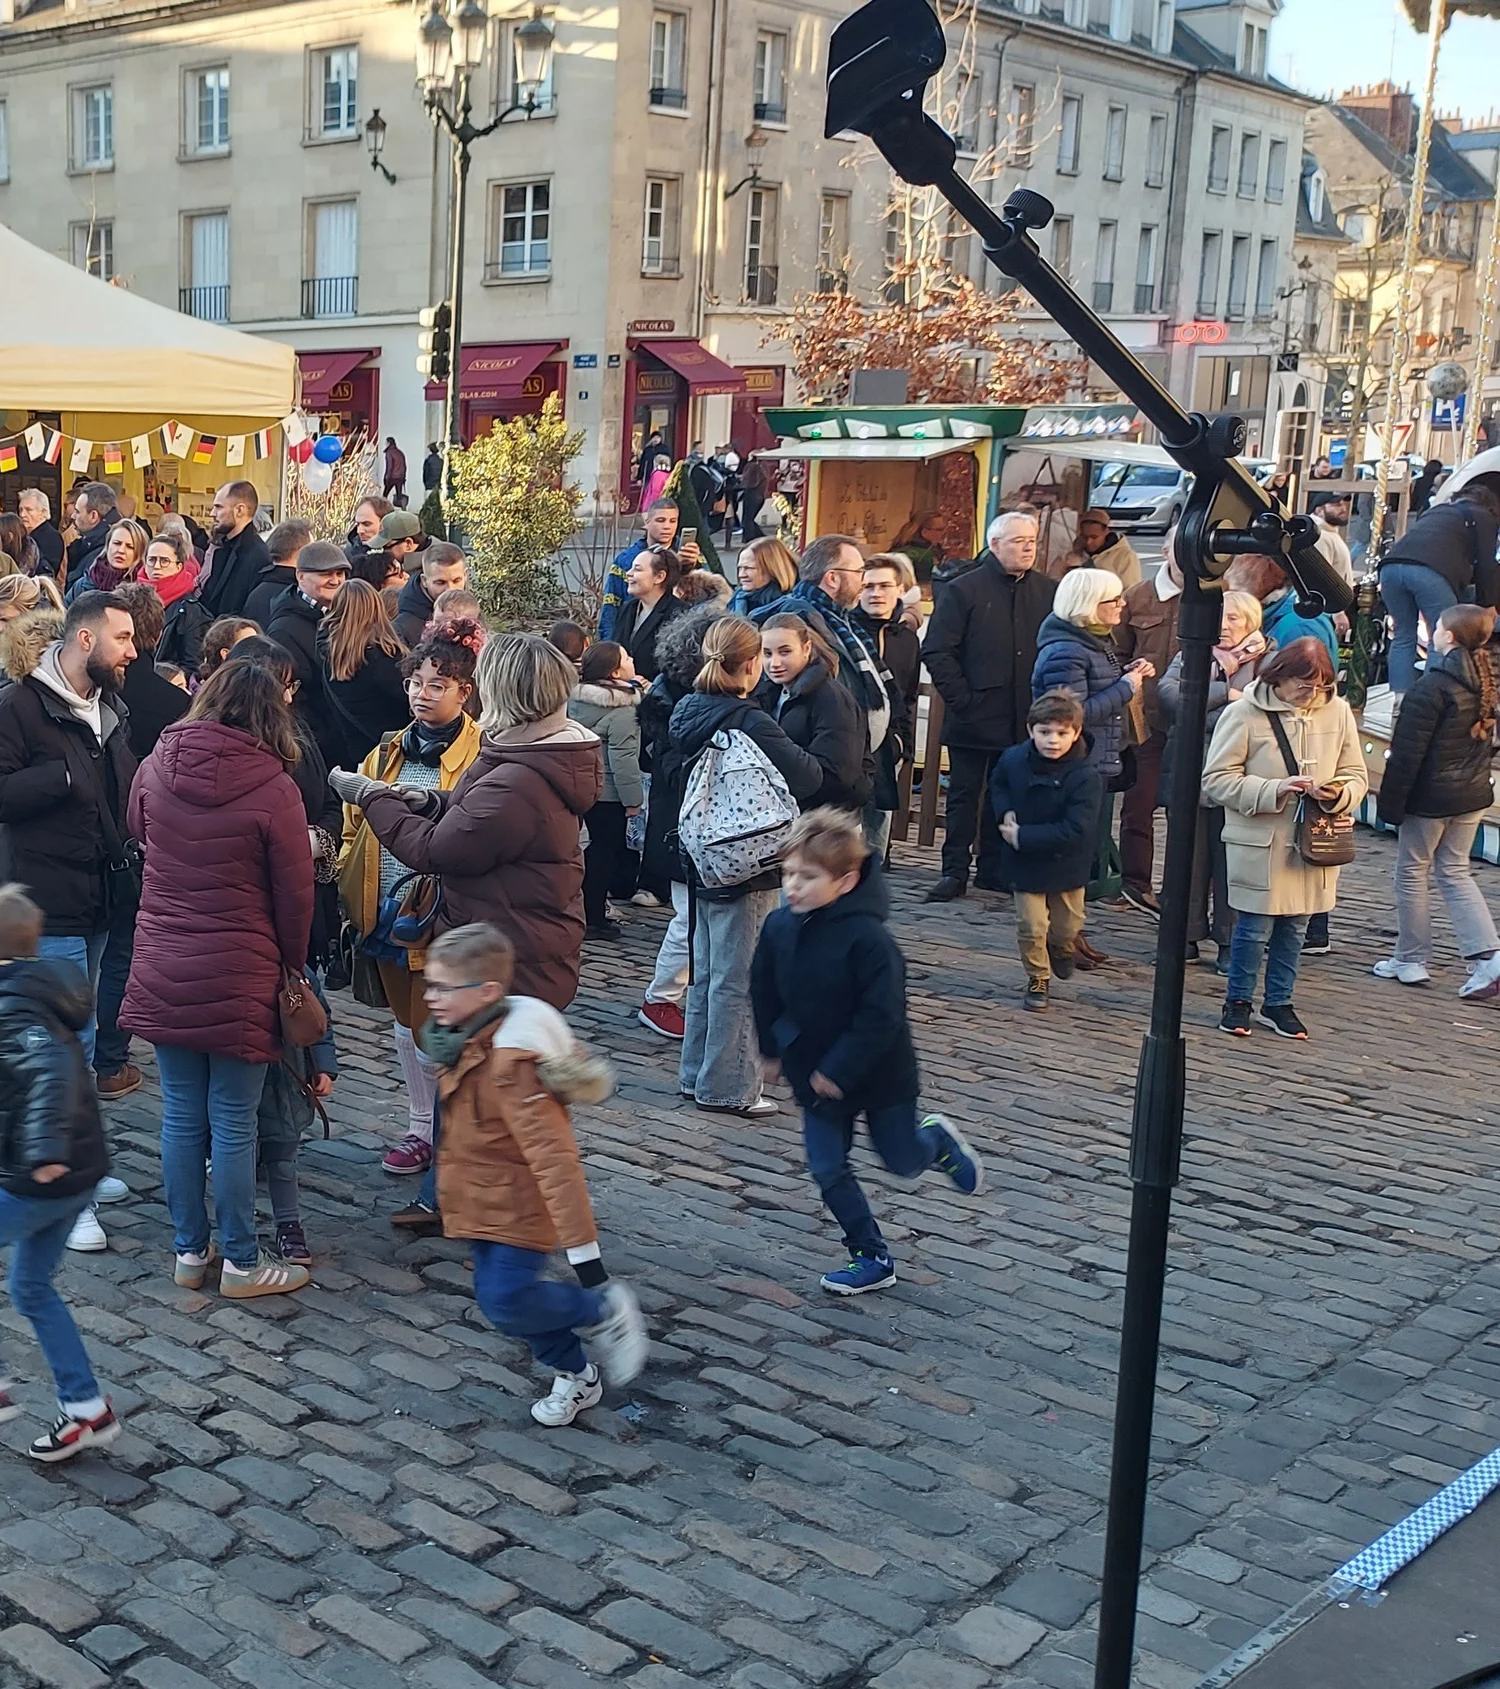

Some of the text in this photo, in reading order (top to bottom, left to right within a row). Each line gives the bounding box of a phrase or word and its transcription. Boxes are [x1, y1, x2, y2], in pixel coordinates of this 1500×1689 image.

[635, 321, 670, 331] NICOLAS
[640, 375, 673, 388] NICOLAS
[459, 391, 498, 399] OLAS.COM
[572, 1391, 585, 1405] N
